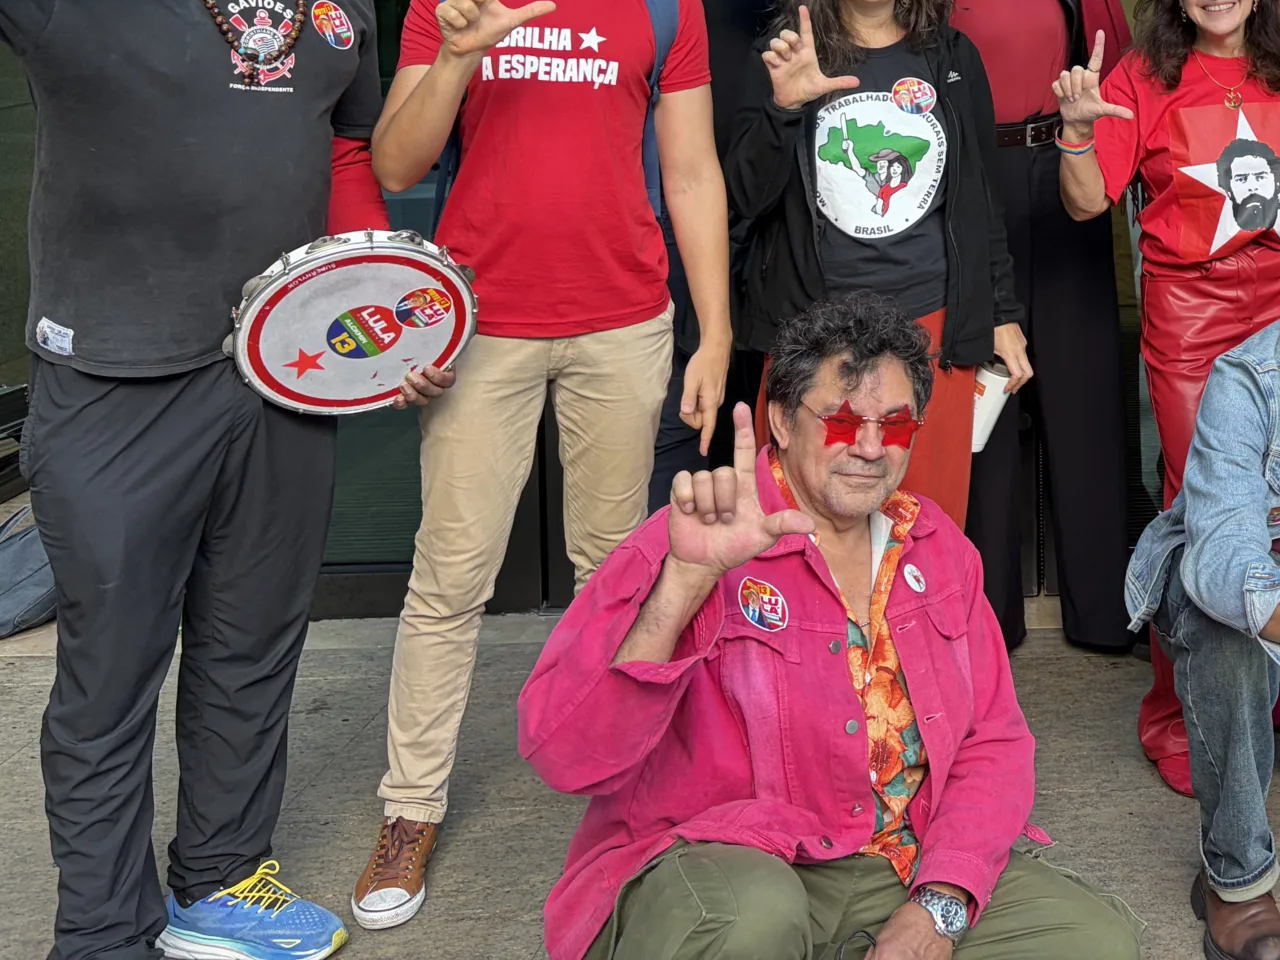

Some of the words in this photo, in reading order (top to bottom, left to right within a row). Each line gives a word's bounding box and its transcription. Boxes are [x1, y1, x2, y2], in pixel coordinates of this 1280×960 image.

[482, 56, 495, 81] A
[498, 54, 619, 90] ESPERANÇA
[250, 85, 294, 93] INDEPENDENTE
[935, 150, 945, 174] SEM
[916, 177, 939, 210] TERRA
[854, 224, 895, 236] BRASIL
[344, 319, 368, 344] ALCKMIN
[360, 307, 396, 345] LULA
[330, 332, 357, 354] 13
[759, 586, 768, 595] 13
